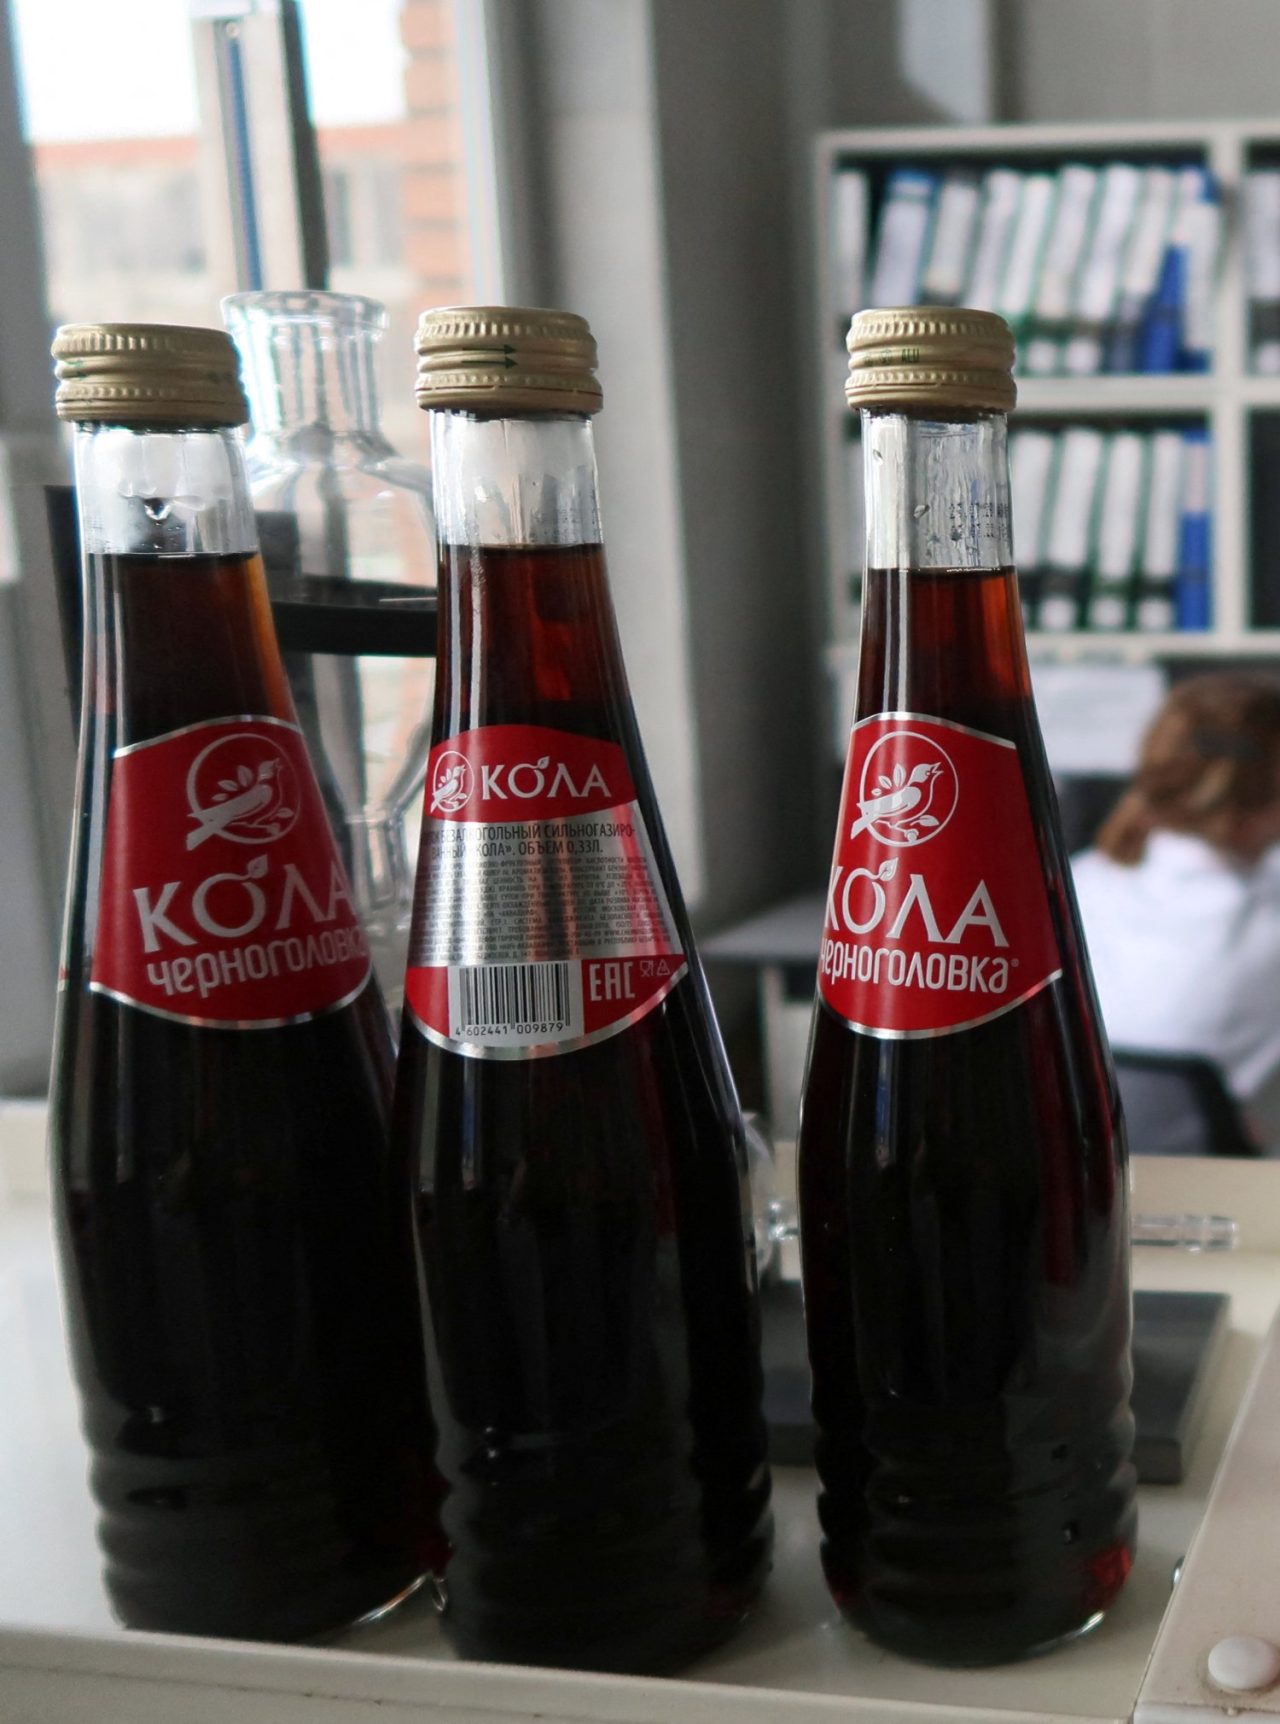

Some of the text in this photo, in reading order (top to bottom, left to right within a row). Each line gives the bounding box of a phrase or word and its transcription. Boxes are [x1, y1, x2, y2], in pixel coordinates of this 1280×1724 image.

[480, 758, 613, 801] КОЛА
[440, 823, 636, 843] БЕЗАЛОГОЛЬНЫЙ СИЛЬНОГАЗИРО-
[518, 840, 564, 856] ОБЪЕМ
[133, 858, 359, 953] КОЛА
[825, 861, 1010, 948] КОЛА
[466, 1025, 509, 1037] 602441
[516, 1022, 564, 1034] 009879
